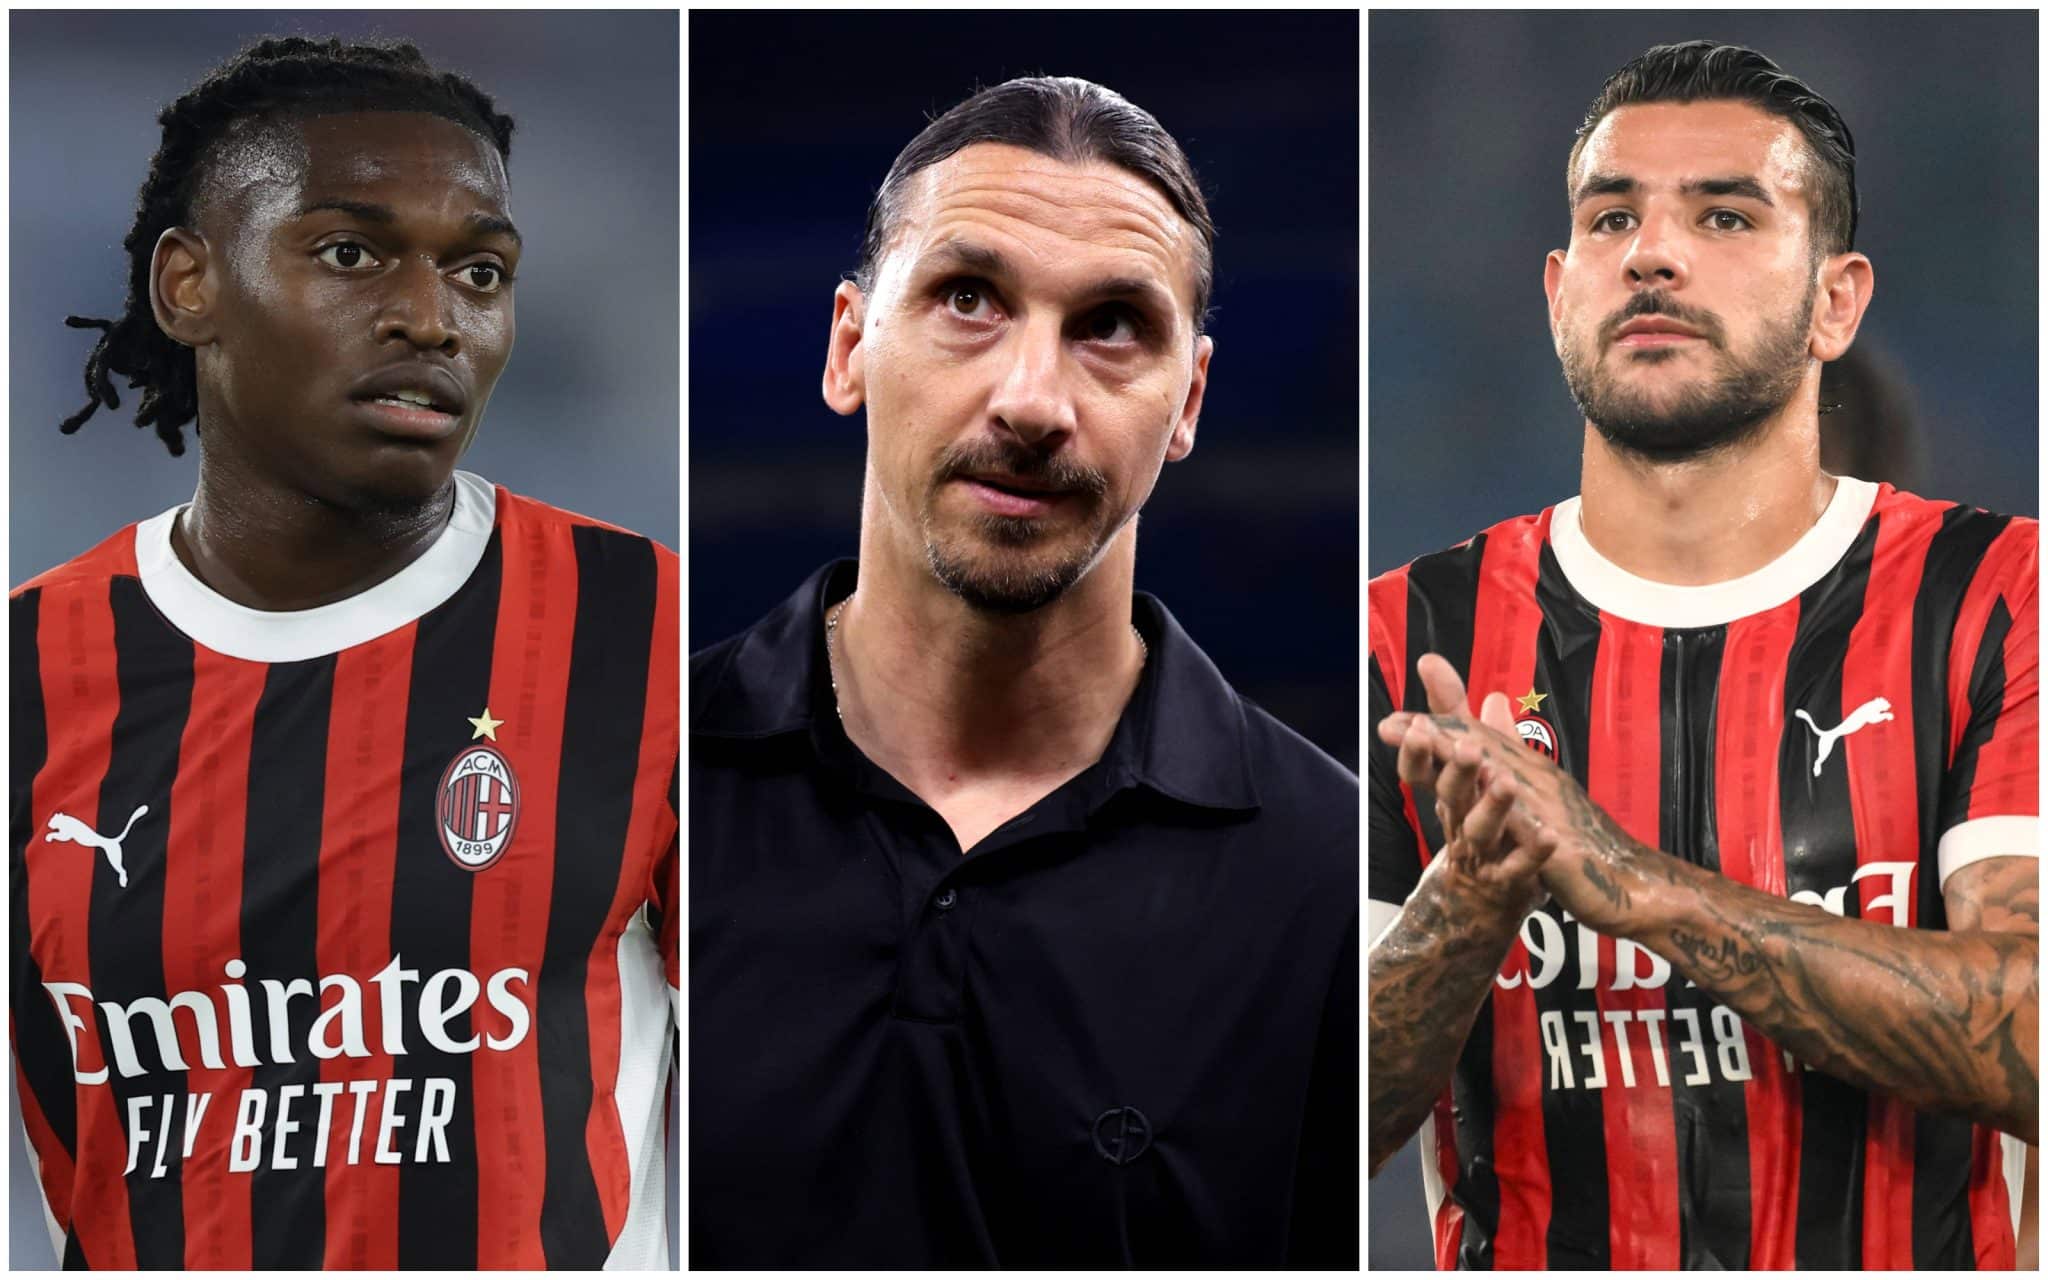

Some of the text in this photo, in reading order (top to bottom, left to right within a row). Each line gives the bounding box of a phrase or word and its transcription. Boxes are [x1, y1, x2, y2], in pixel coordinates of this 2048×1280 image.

[458, 755, 502, 777] ACM
[455, 841, 493, 856] 1899
[41, 952, 531, 1085] Emirates
[122, 1077, 457, 1179] FLY BETTER
